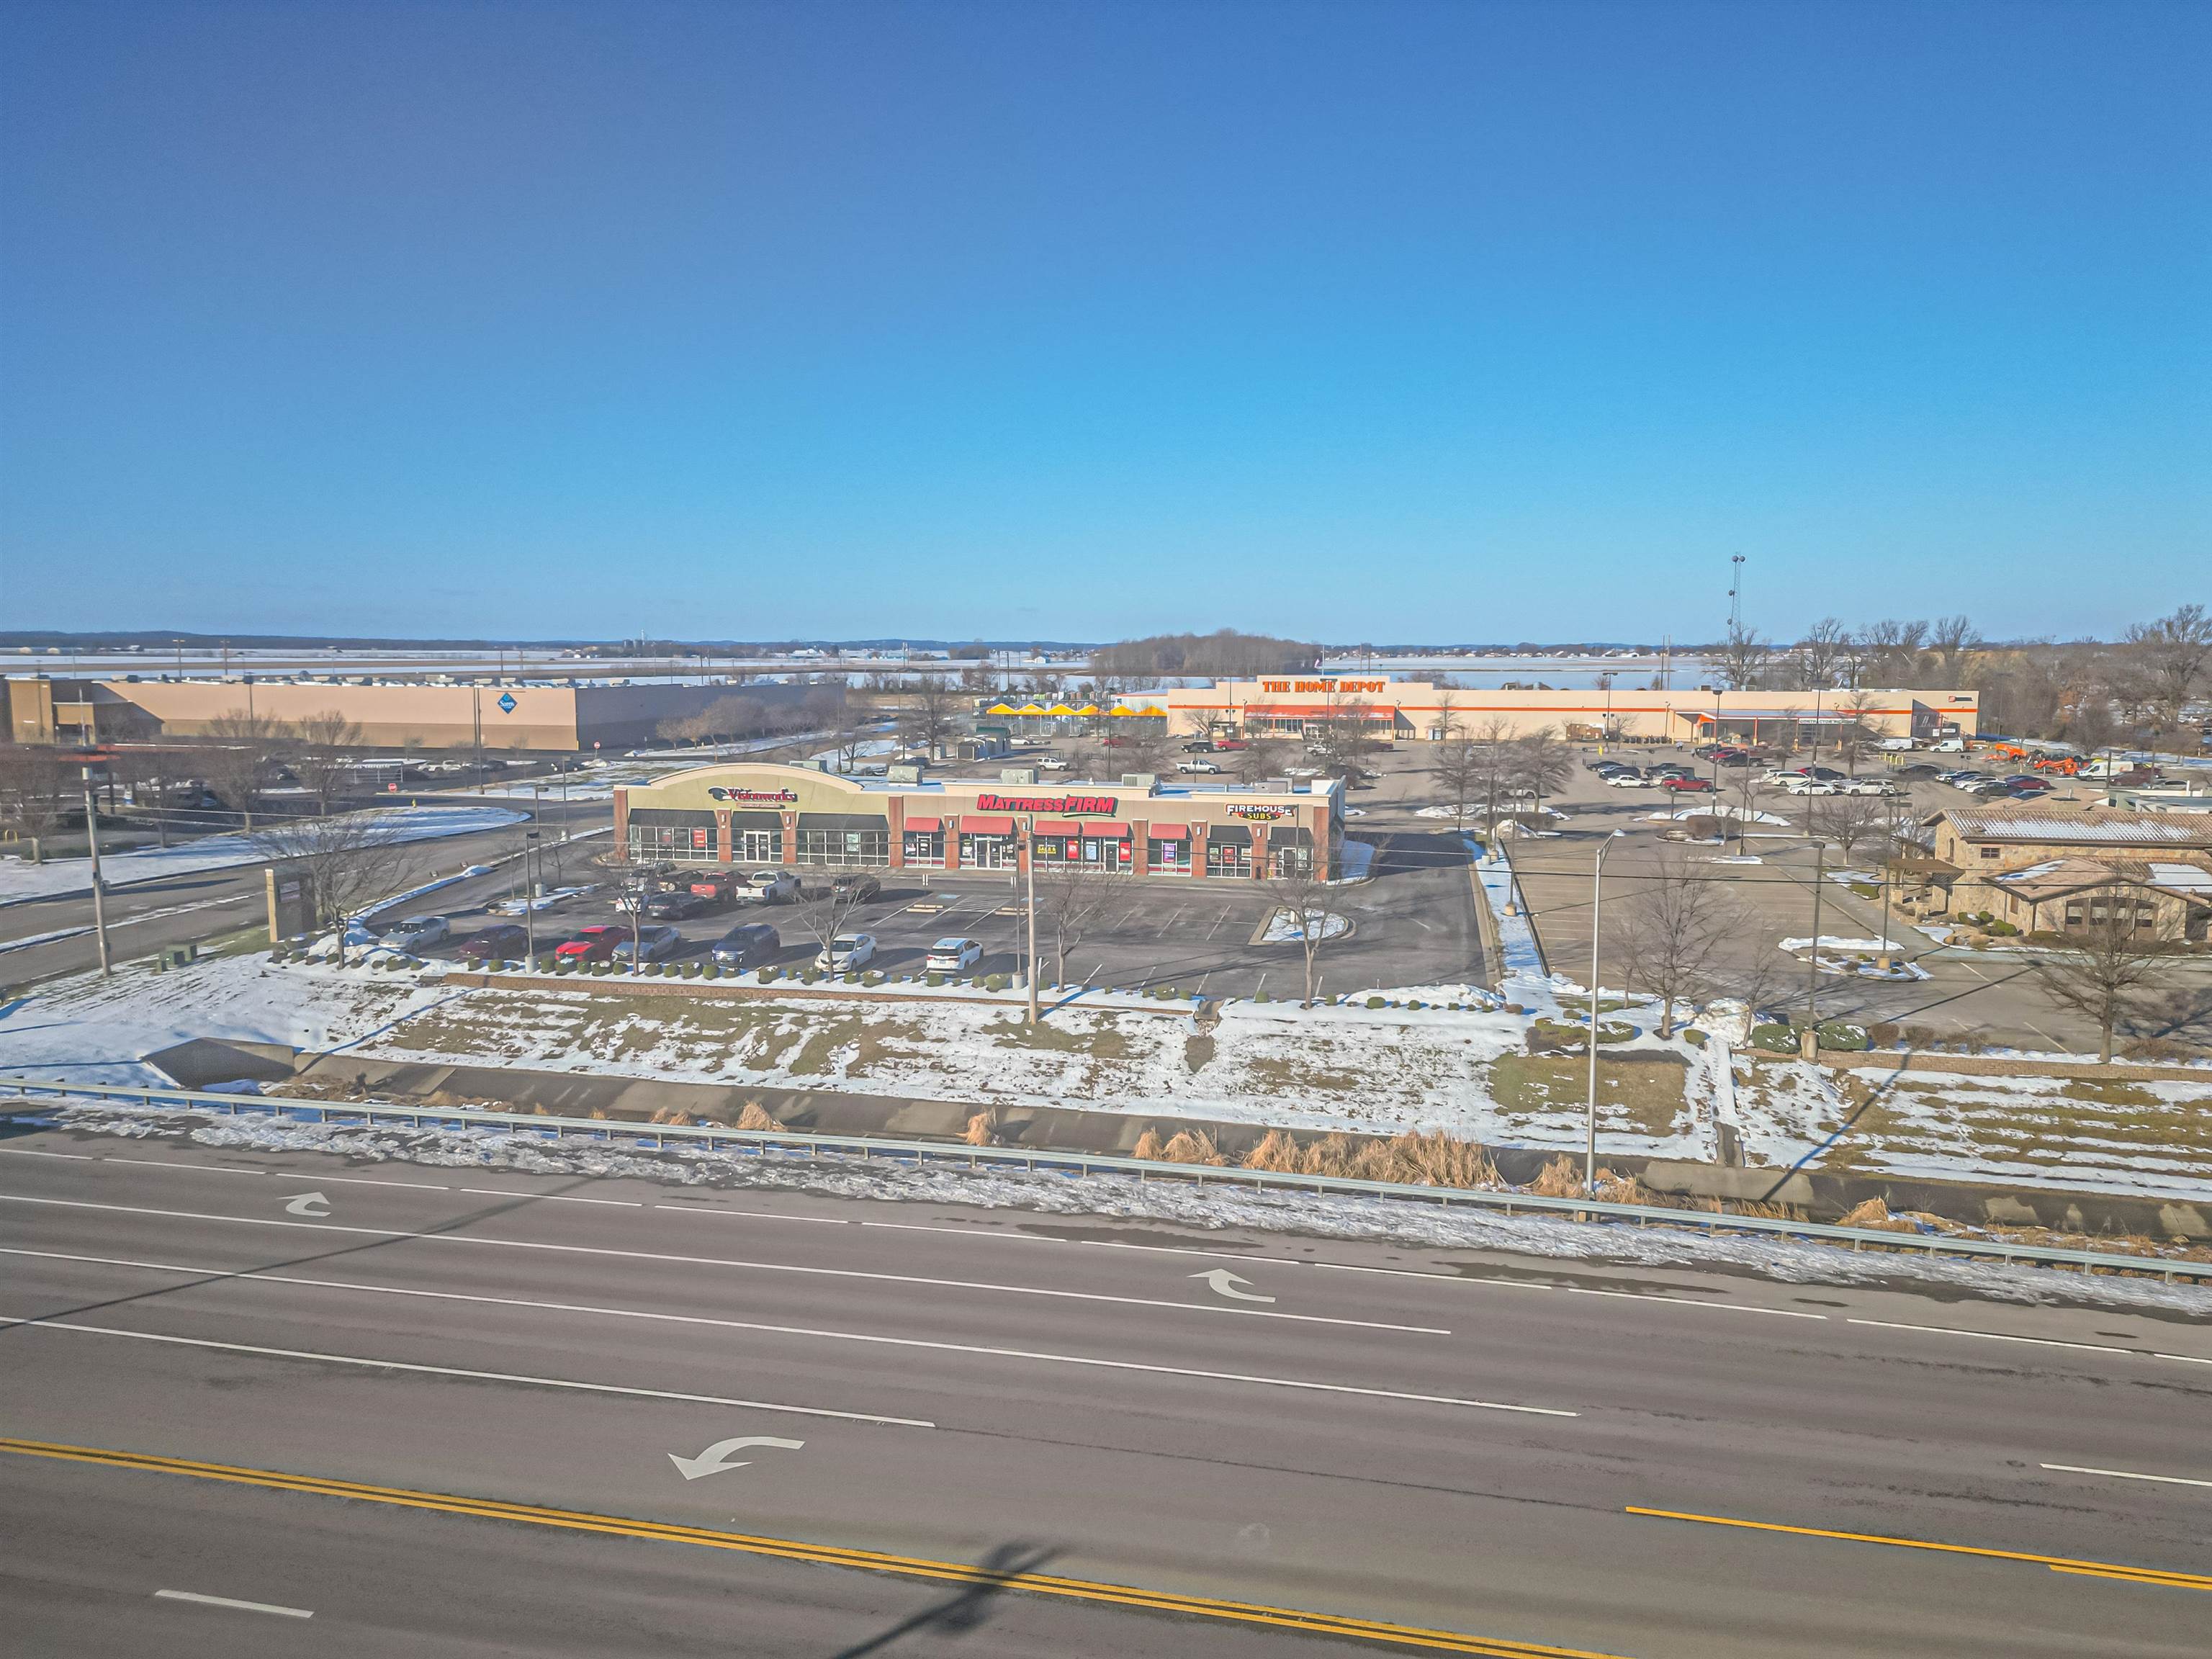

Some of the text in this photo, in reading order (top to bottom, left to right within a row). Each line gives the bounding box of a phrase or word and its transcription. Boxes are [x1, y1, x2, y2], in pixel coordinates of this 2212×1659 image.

[1262, 680, 1385, 693] THE HOME DEPOT
[727, 787, 795, 802] Visionworks
[1226, 804, 1293, 816] FIREHOUSE
